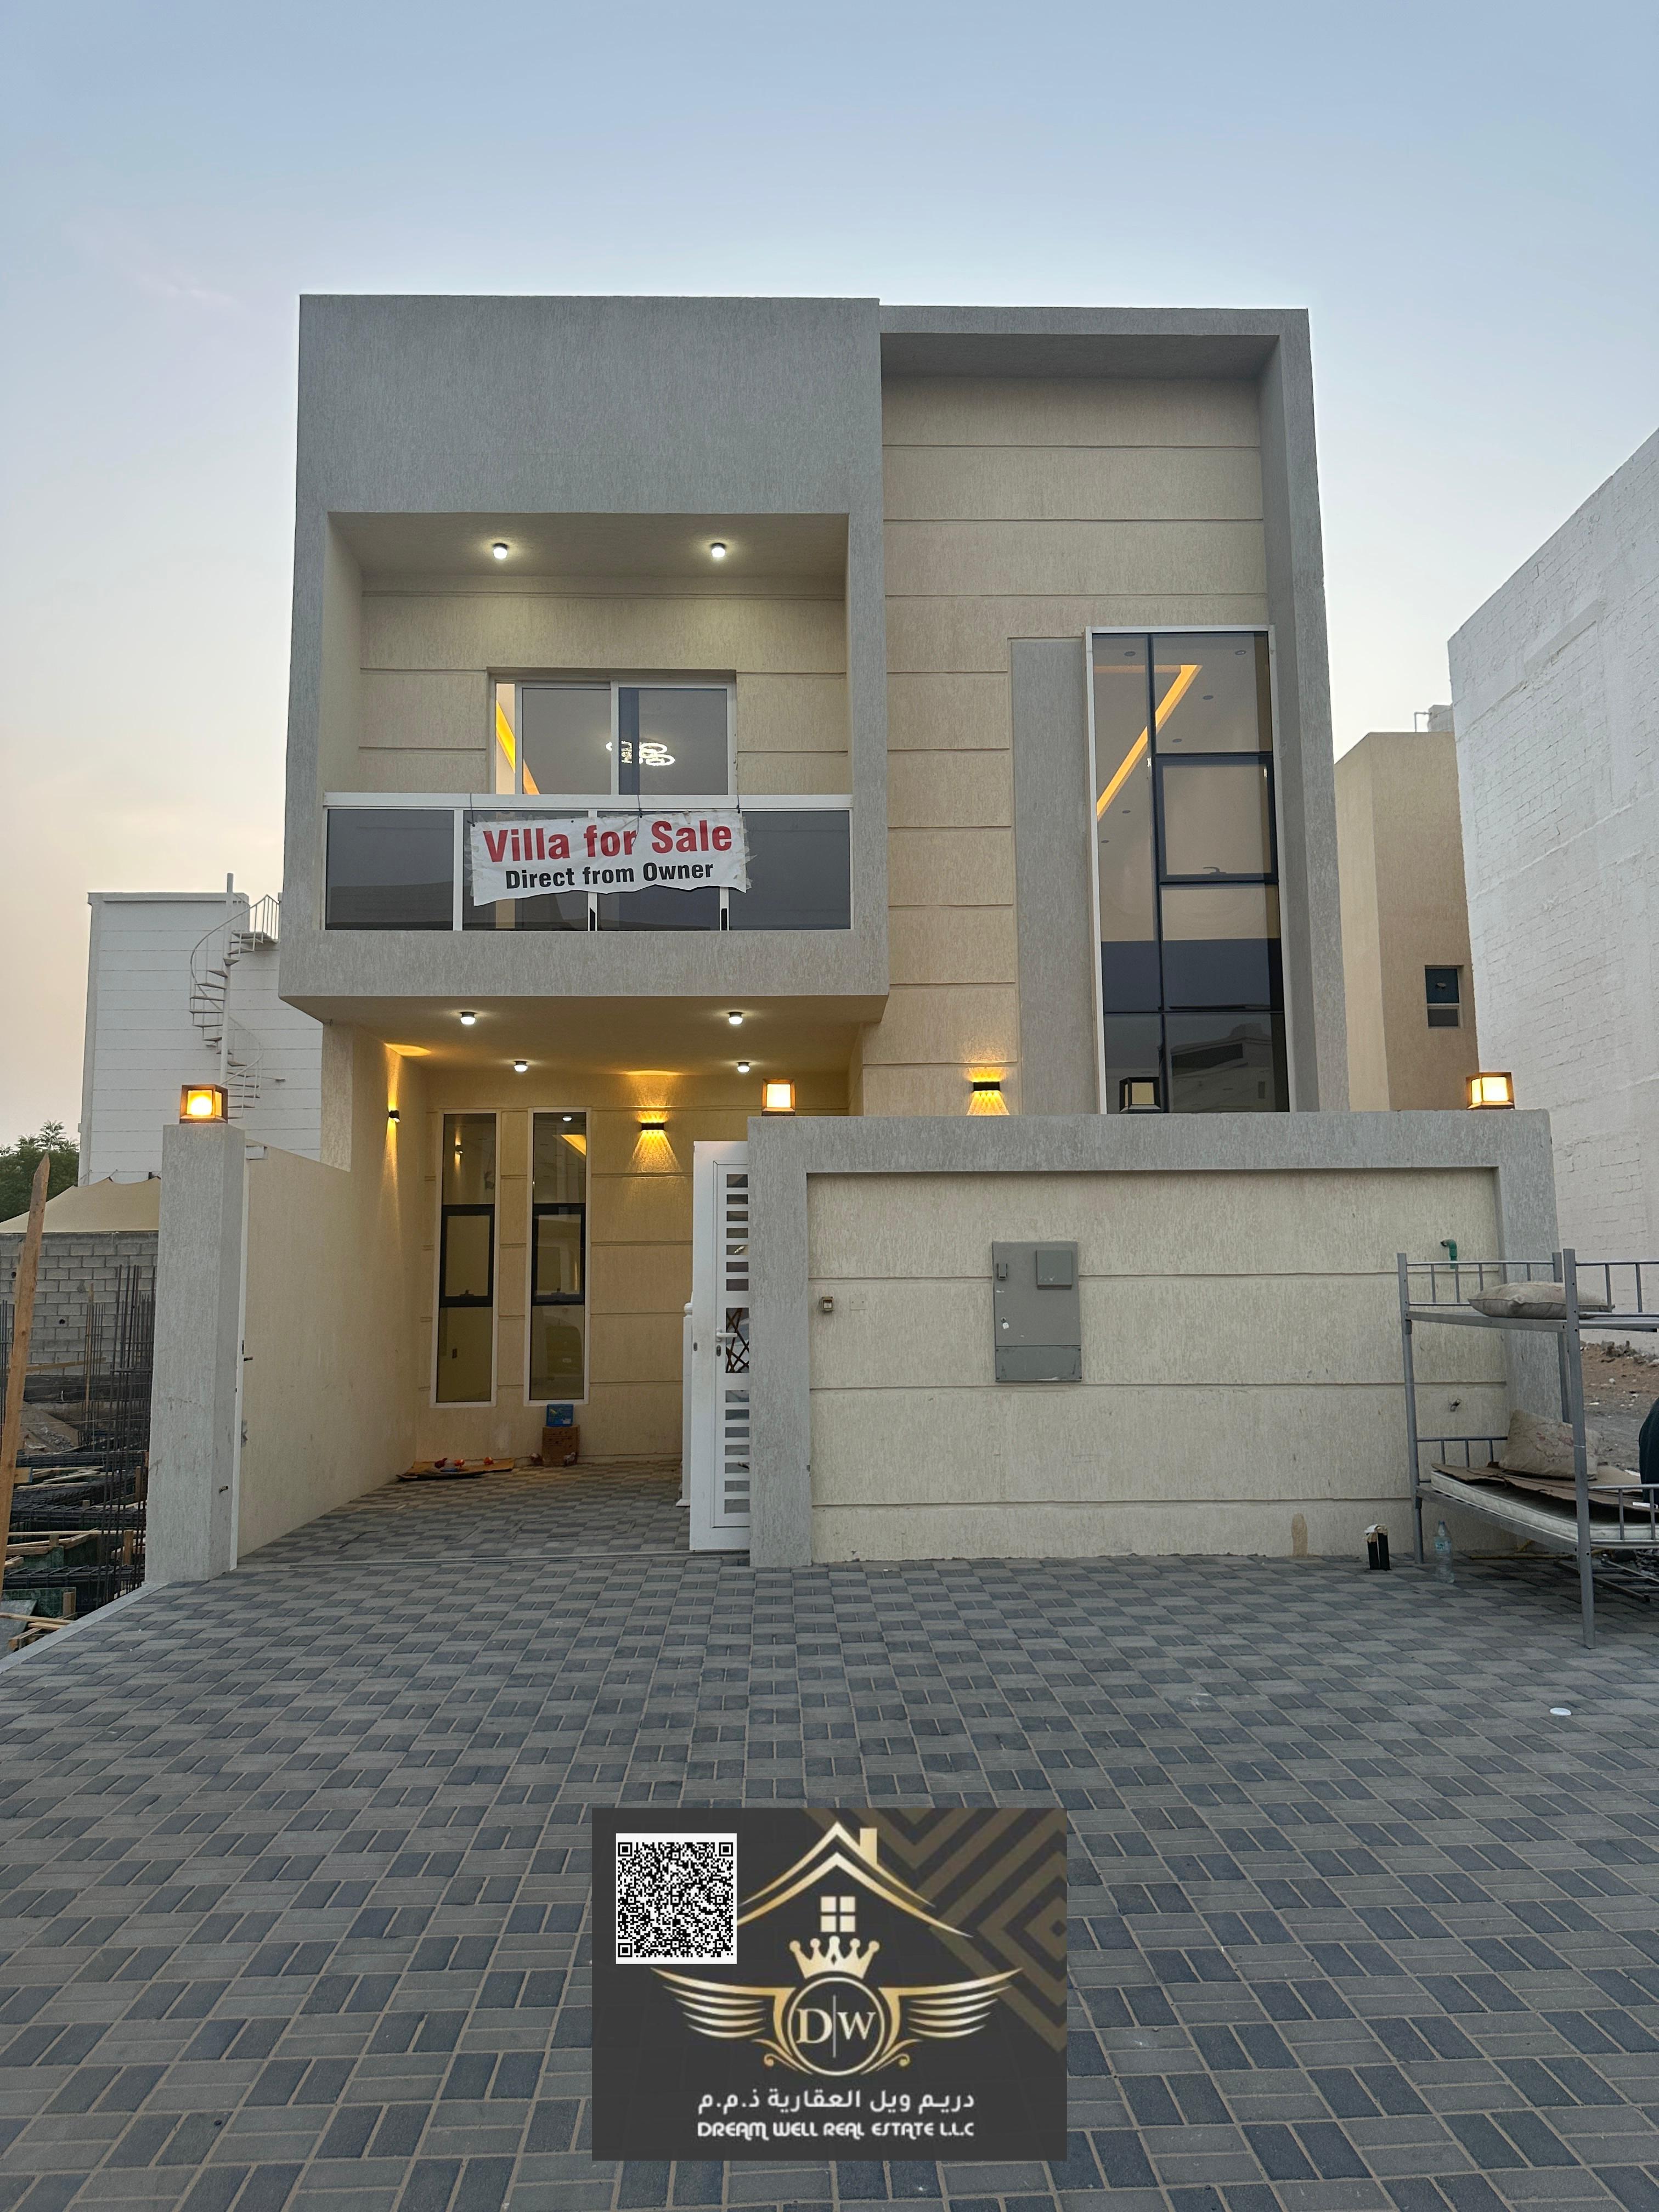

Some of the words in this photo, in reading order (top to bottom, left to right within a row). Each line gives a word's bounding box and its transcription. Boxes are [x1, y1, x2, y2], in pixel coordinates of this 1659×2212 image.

[483, 828, 570, 862] Villa
[583, 825, 636, 857] for
[651, 820, 732, 854] Sale
[505, 867, 575, 889] Direct
[582, 866, 635, 885] from
[643, 862, 714, 882] Owner
